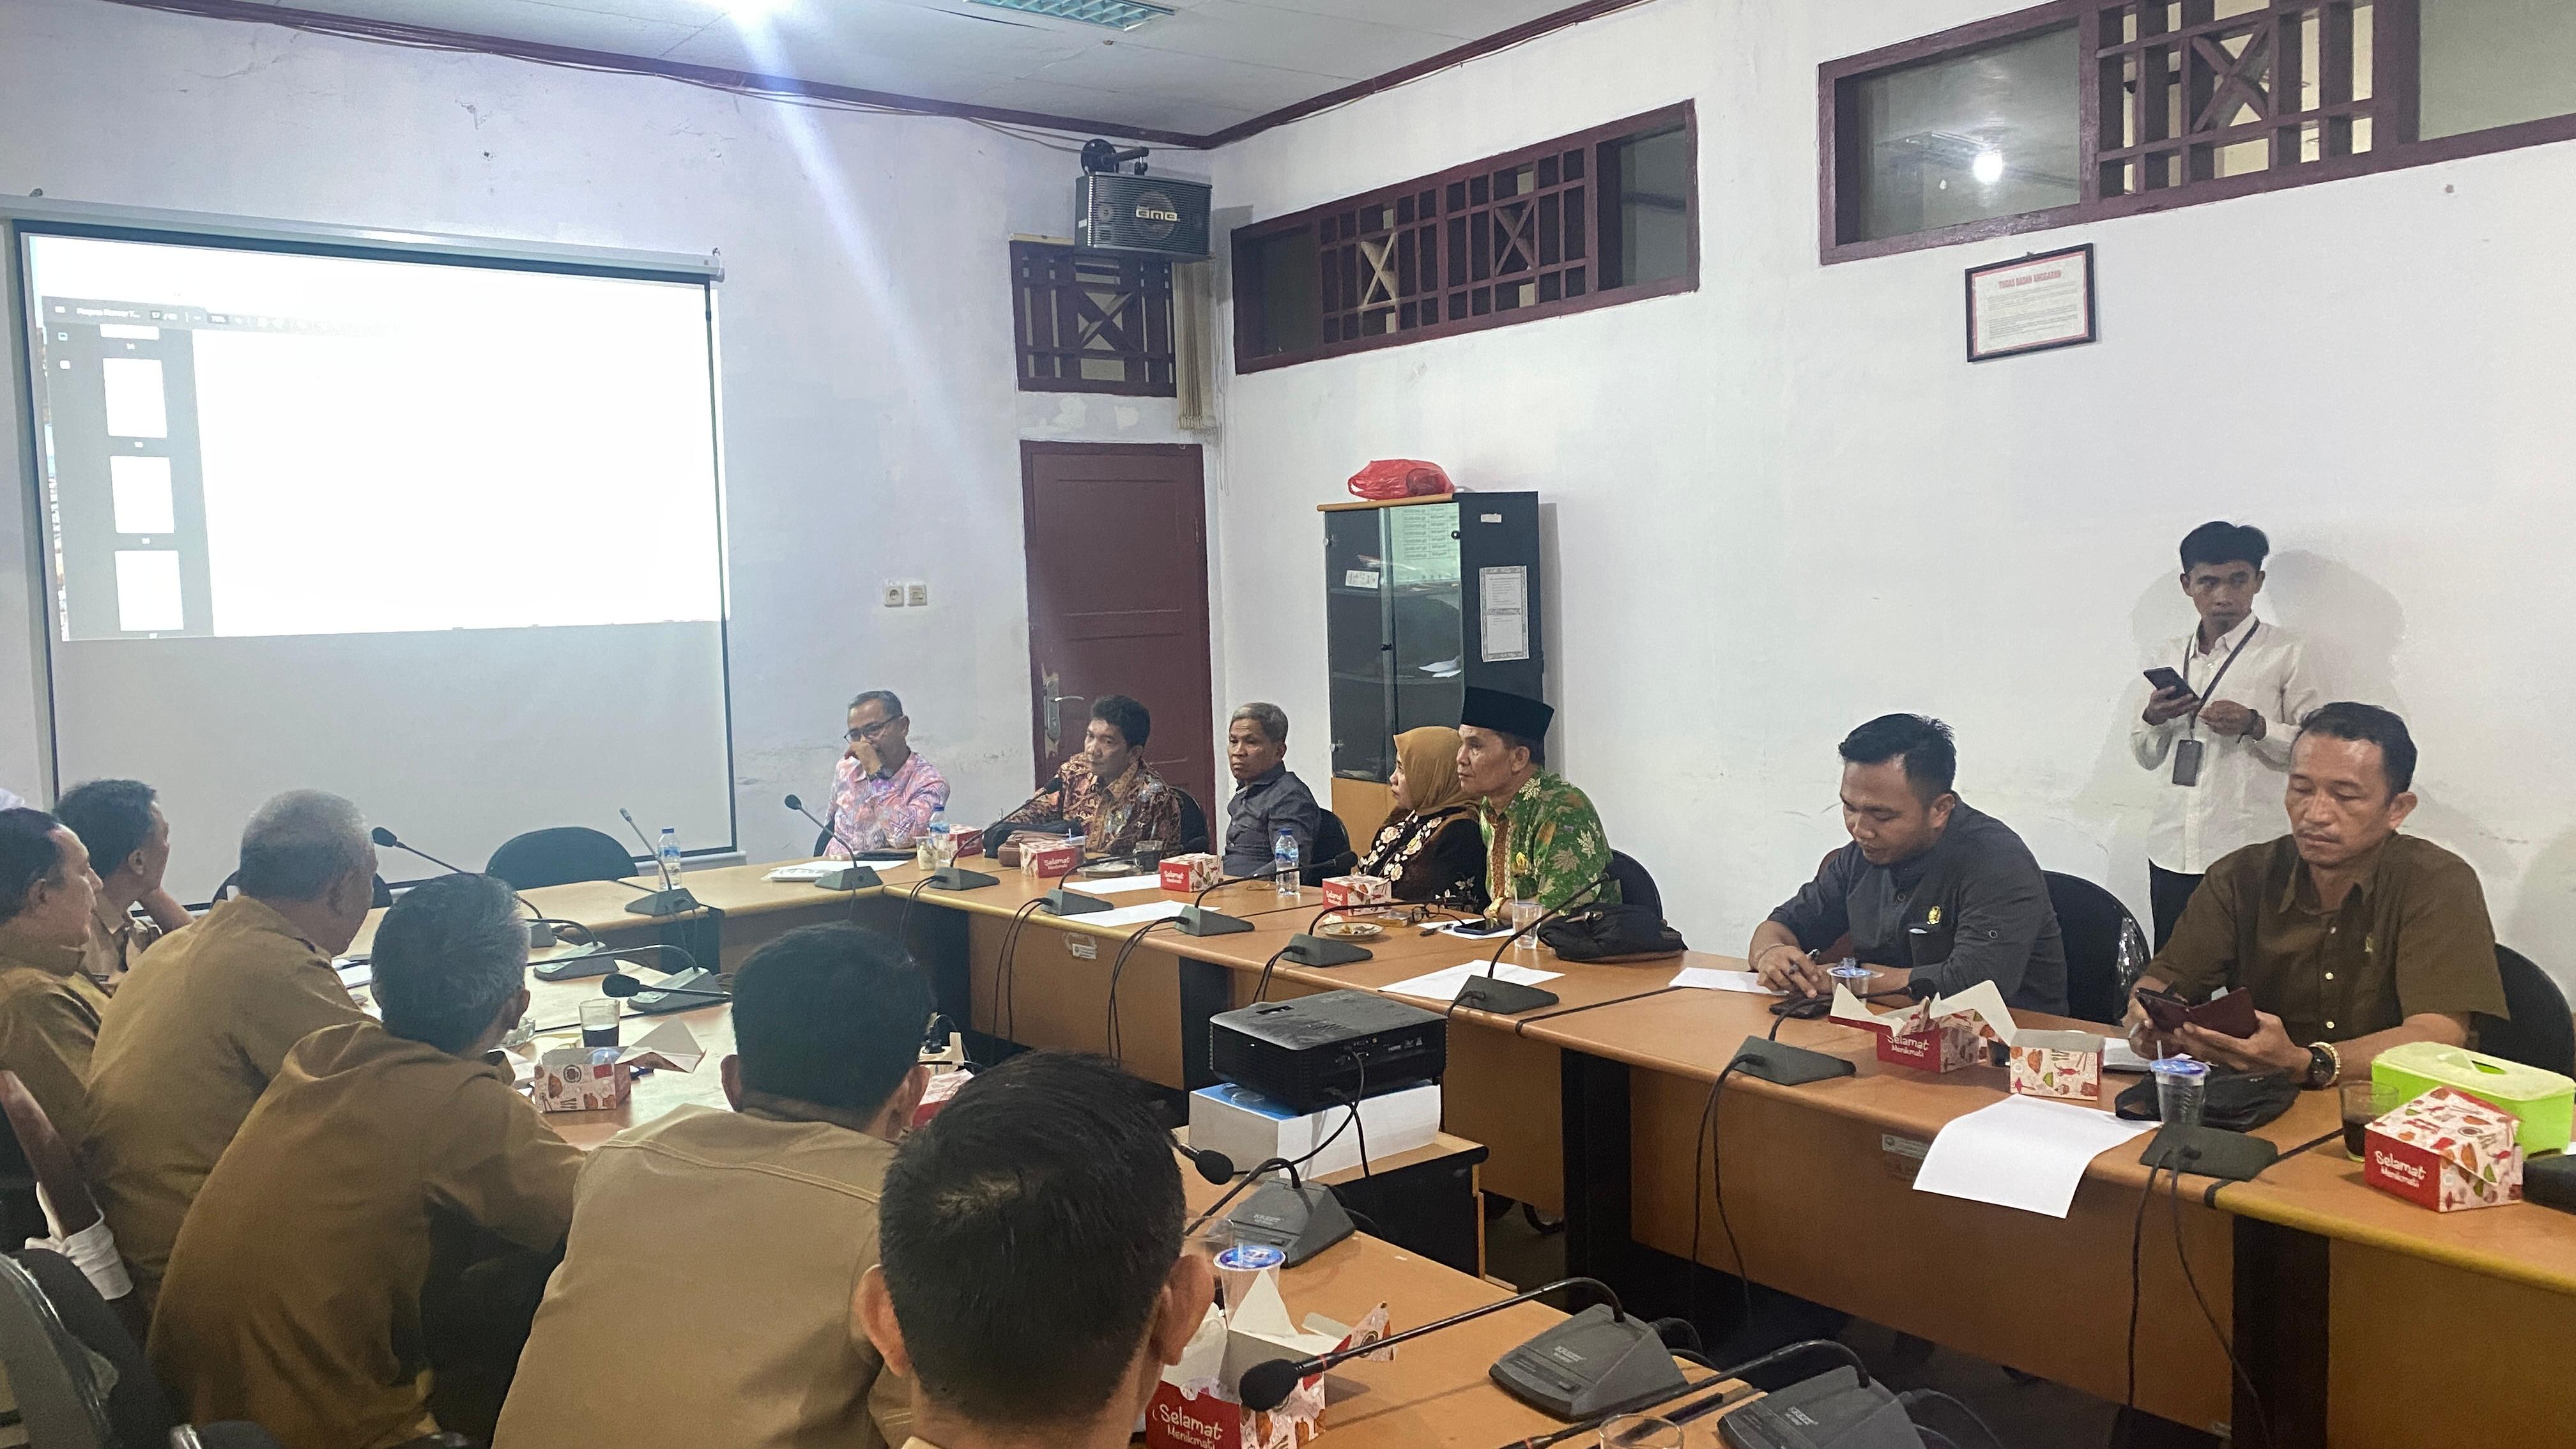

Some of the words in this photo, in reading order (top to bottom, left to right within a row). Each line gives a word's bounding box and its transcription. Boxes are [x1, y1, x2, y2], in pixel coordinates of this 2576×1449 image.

[1044, 856, 1071, 866] Selamat
[1886, 1035, 1929, 1050] Selamat
[2374, 1150, 2427, 1180] Selamat
[1160, 1404, 1223, 1440] Selamat
[1167, 1423, 1215, 1449] Menikmati
